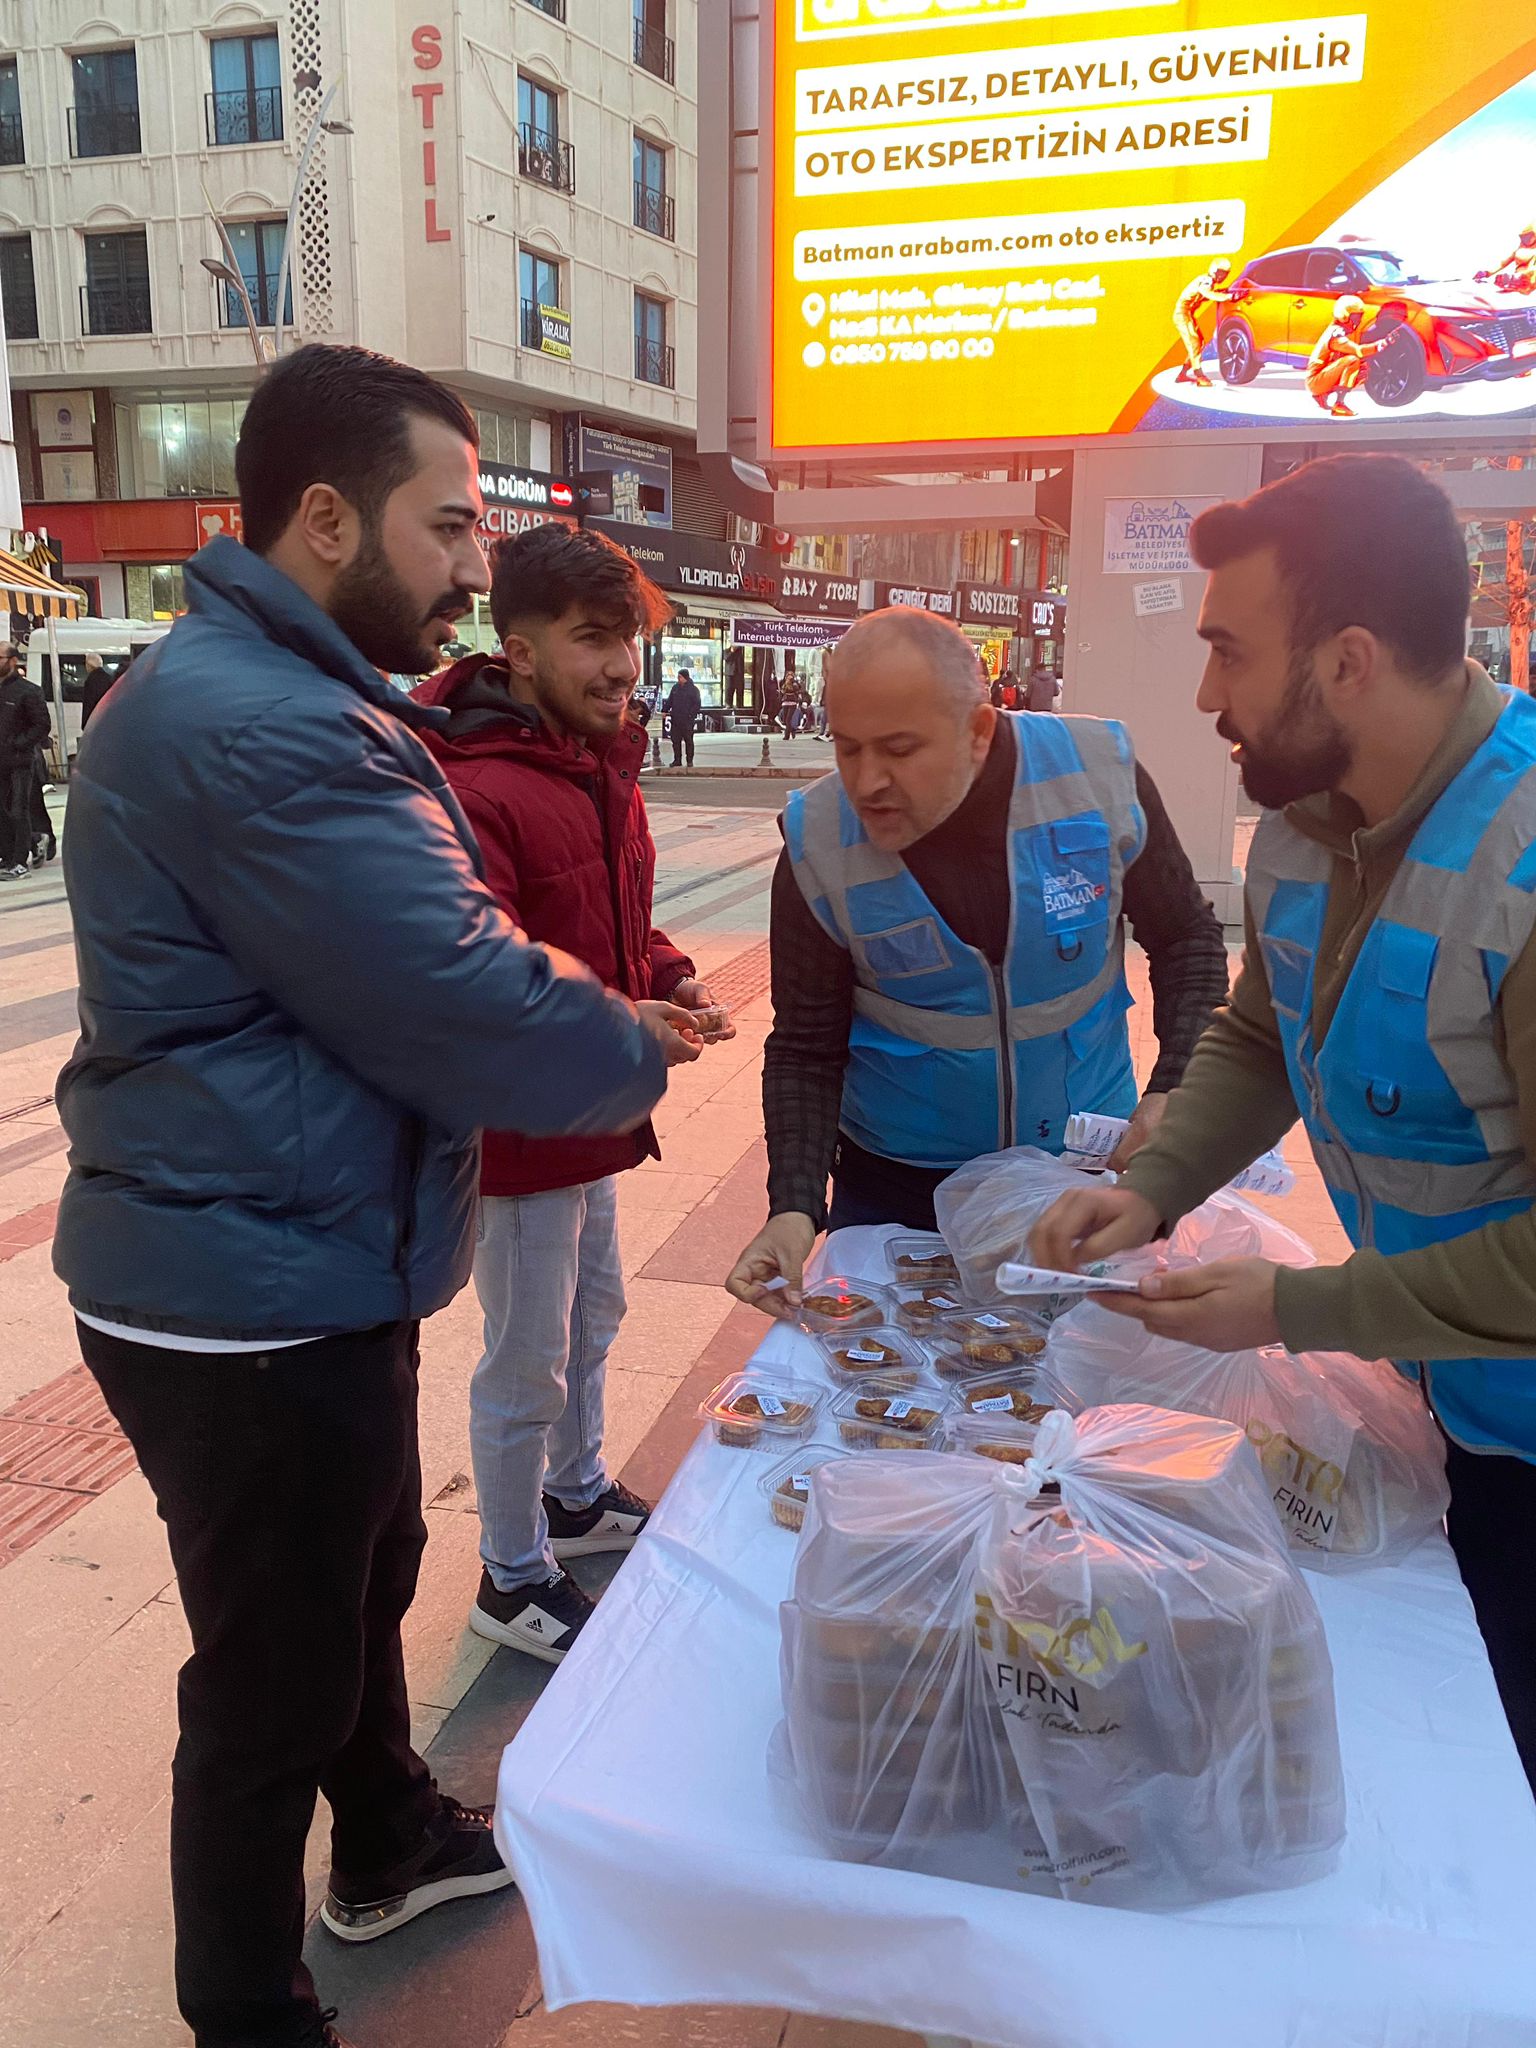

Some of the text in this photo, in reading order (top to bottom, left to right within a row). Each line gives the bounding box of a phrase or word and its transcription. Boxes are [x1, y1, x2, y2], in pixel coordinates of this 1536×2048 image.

[806, 31, 1351, 115] TARAFSIZ, DETAYLI, GÜVENİLİR
[805, 105, 1249, 178] OTO EKSPERTİZİN ADRESİ
[803, 215, 1225, 265] Batman arabam.com oto ekspertiz
[541, 316, 570, 342] KİRALIK
[498, 474, 547, 503] DÜRÜM
[630, 545, 664, 562] Telekom
[1108, 550, 1190, 560] İŞLETME VE İŞTİRA
[1135, 540, 1186, 549] BELEDİYESİ
[1129, 560, 1189, 570] MÜDÜRLÜĞÜ
[679, 566, 739, 590] YILDIRIMLAR
[792, 578, 857, 601] BAY STORE
[970, 590, 1019, 616] SOSYETE
[763, 621, 823, 634] Türk Telekom
[777, 634, 811, 645] başvuru
[1043, 886, 1096, 913] BATMAN
[1273, 1486, 1333, 1534] FIRIN
